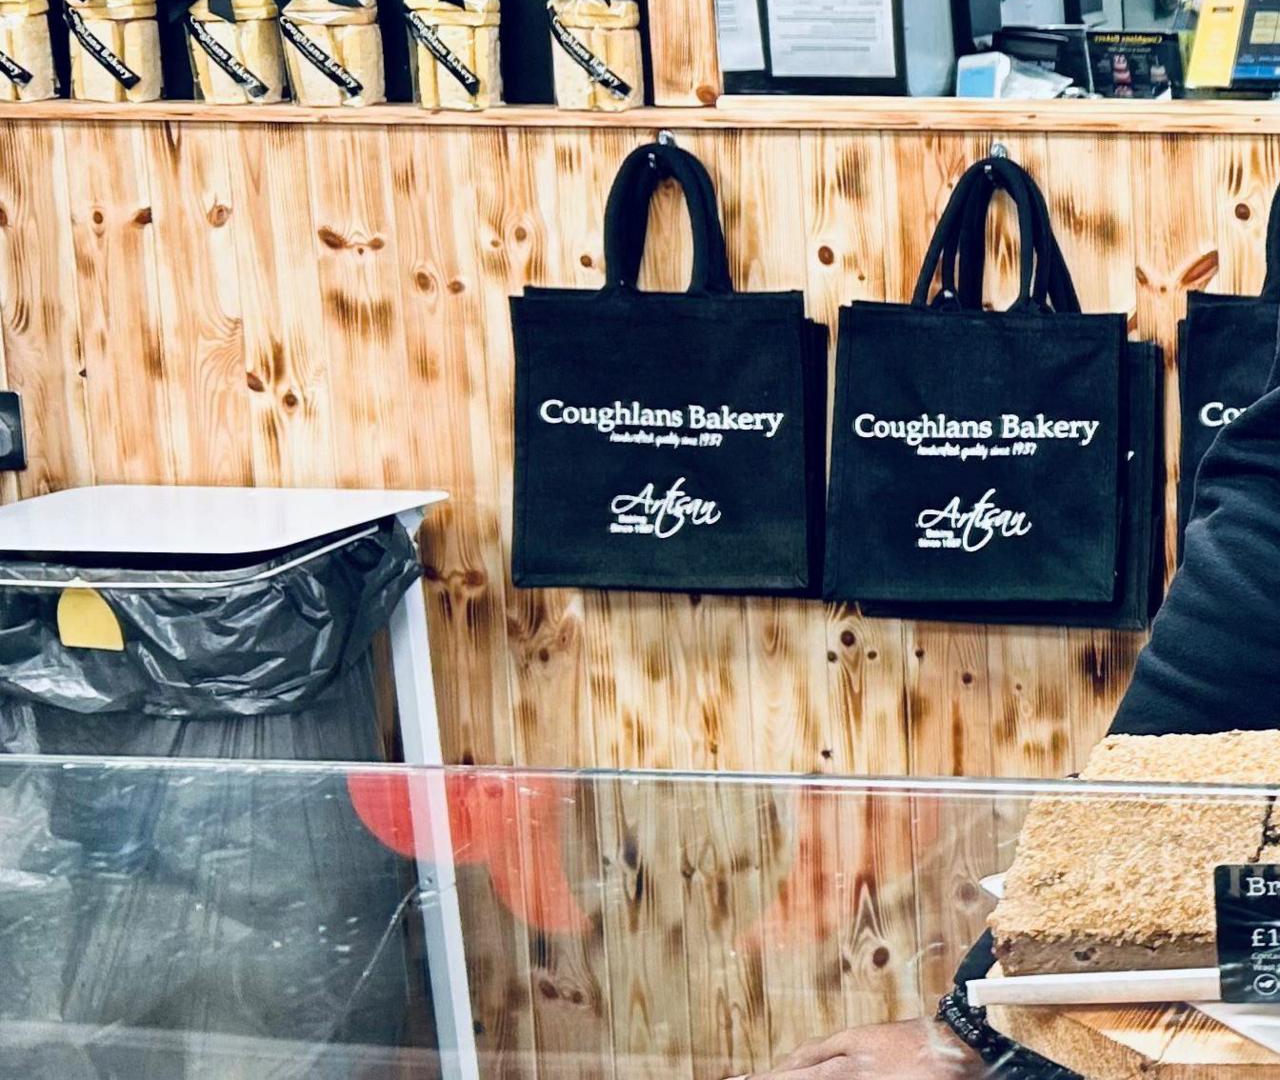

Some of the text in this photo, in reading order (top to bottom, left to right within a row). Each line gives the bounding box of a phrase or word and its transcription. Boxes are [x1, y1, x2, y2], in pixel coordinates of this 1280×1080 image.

[280, 16, 326, 61] Coughlans
[539, 399, 684, 433] Coughlans
[688, 404, 784, 438] Bakery
[854, 413, 1100, 446] Coughlans Bakery
